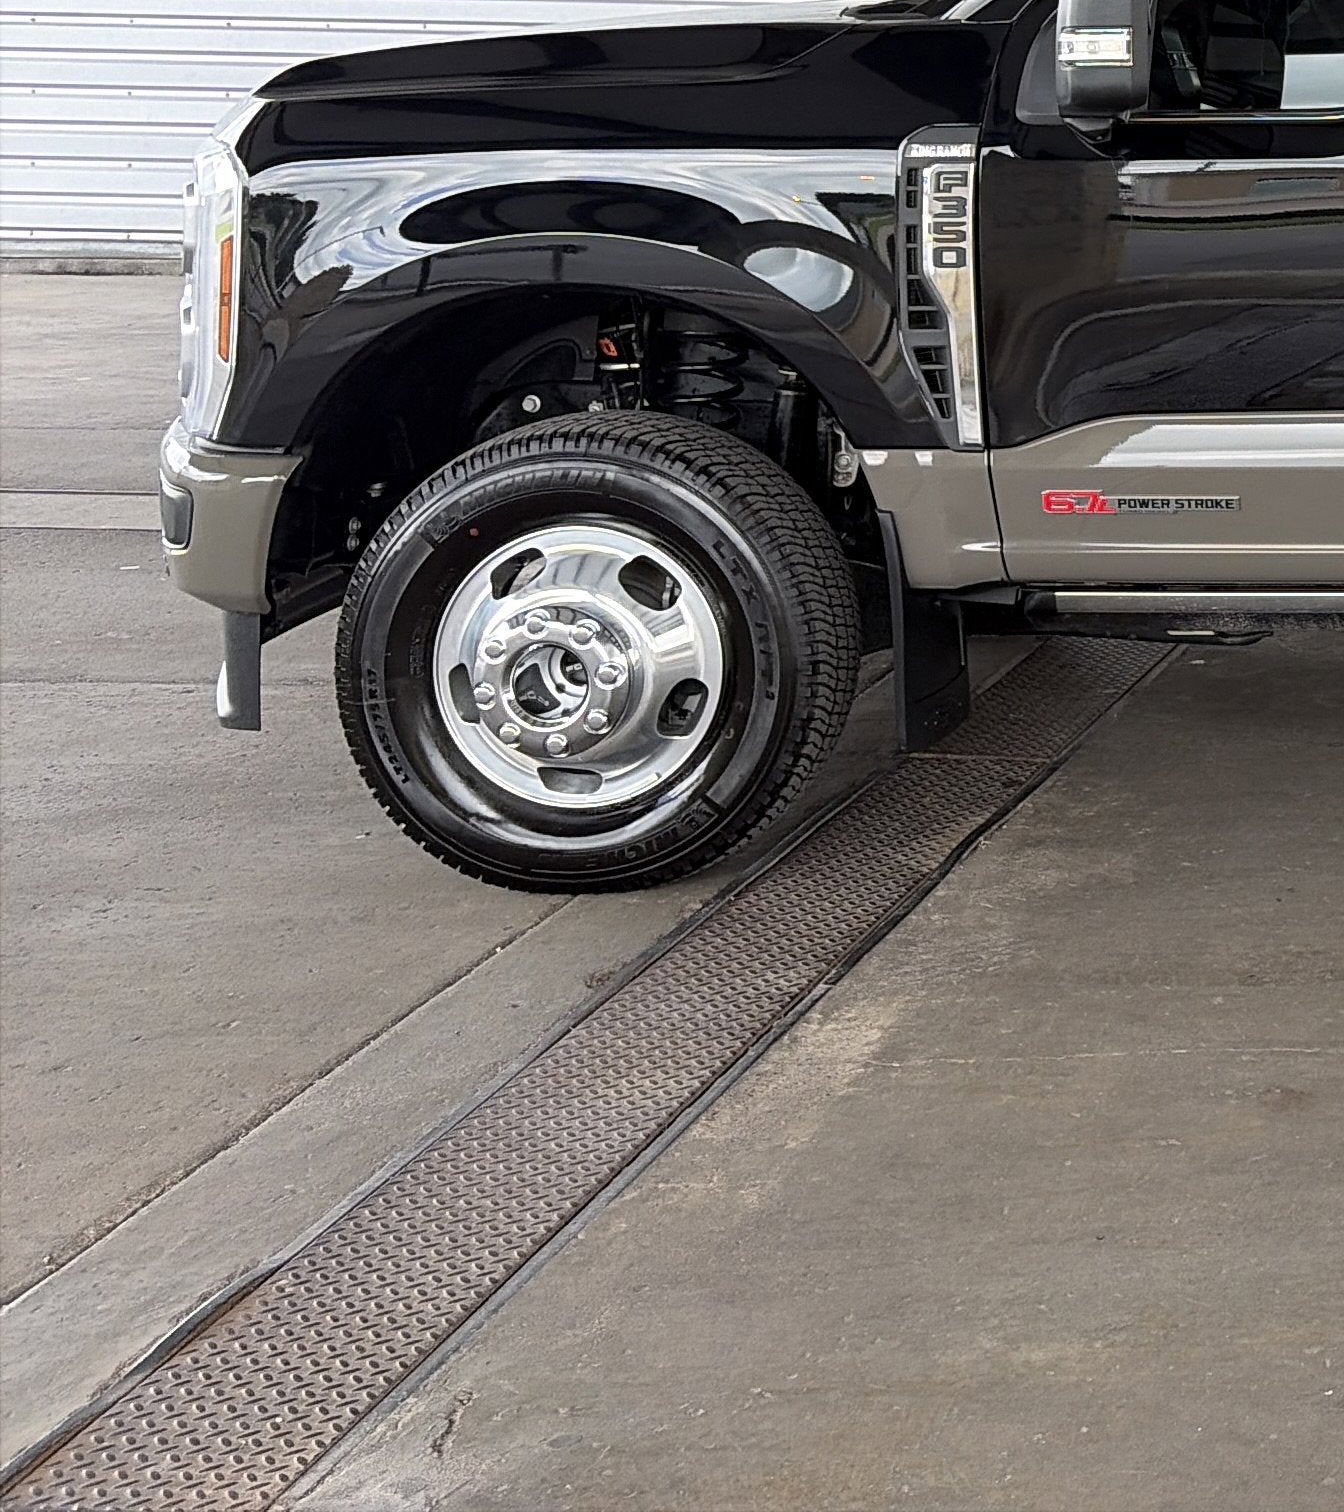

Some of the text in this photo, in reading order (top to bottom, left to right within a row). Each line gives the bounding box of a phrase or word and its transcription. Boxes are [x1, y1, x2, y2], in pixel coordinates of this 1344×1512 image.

[459, 469, 608, 516] MICHELIN
[1042, 489, 1116, 515] 6.7L
[1117, 498, 1170, 510] POWER
[1174, 498, 1235, 510] STROKE
